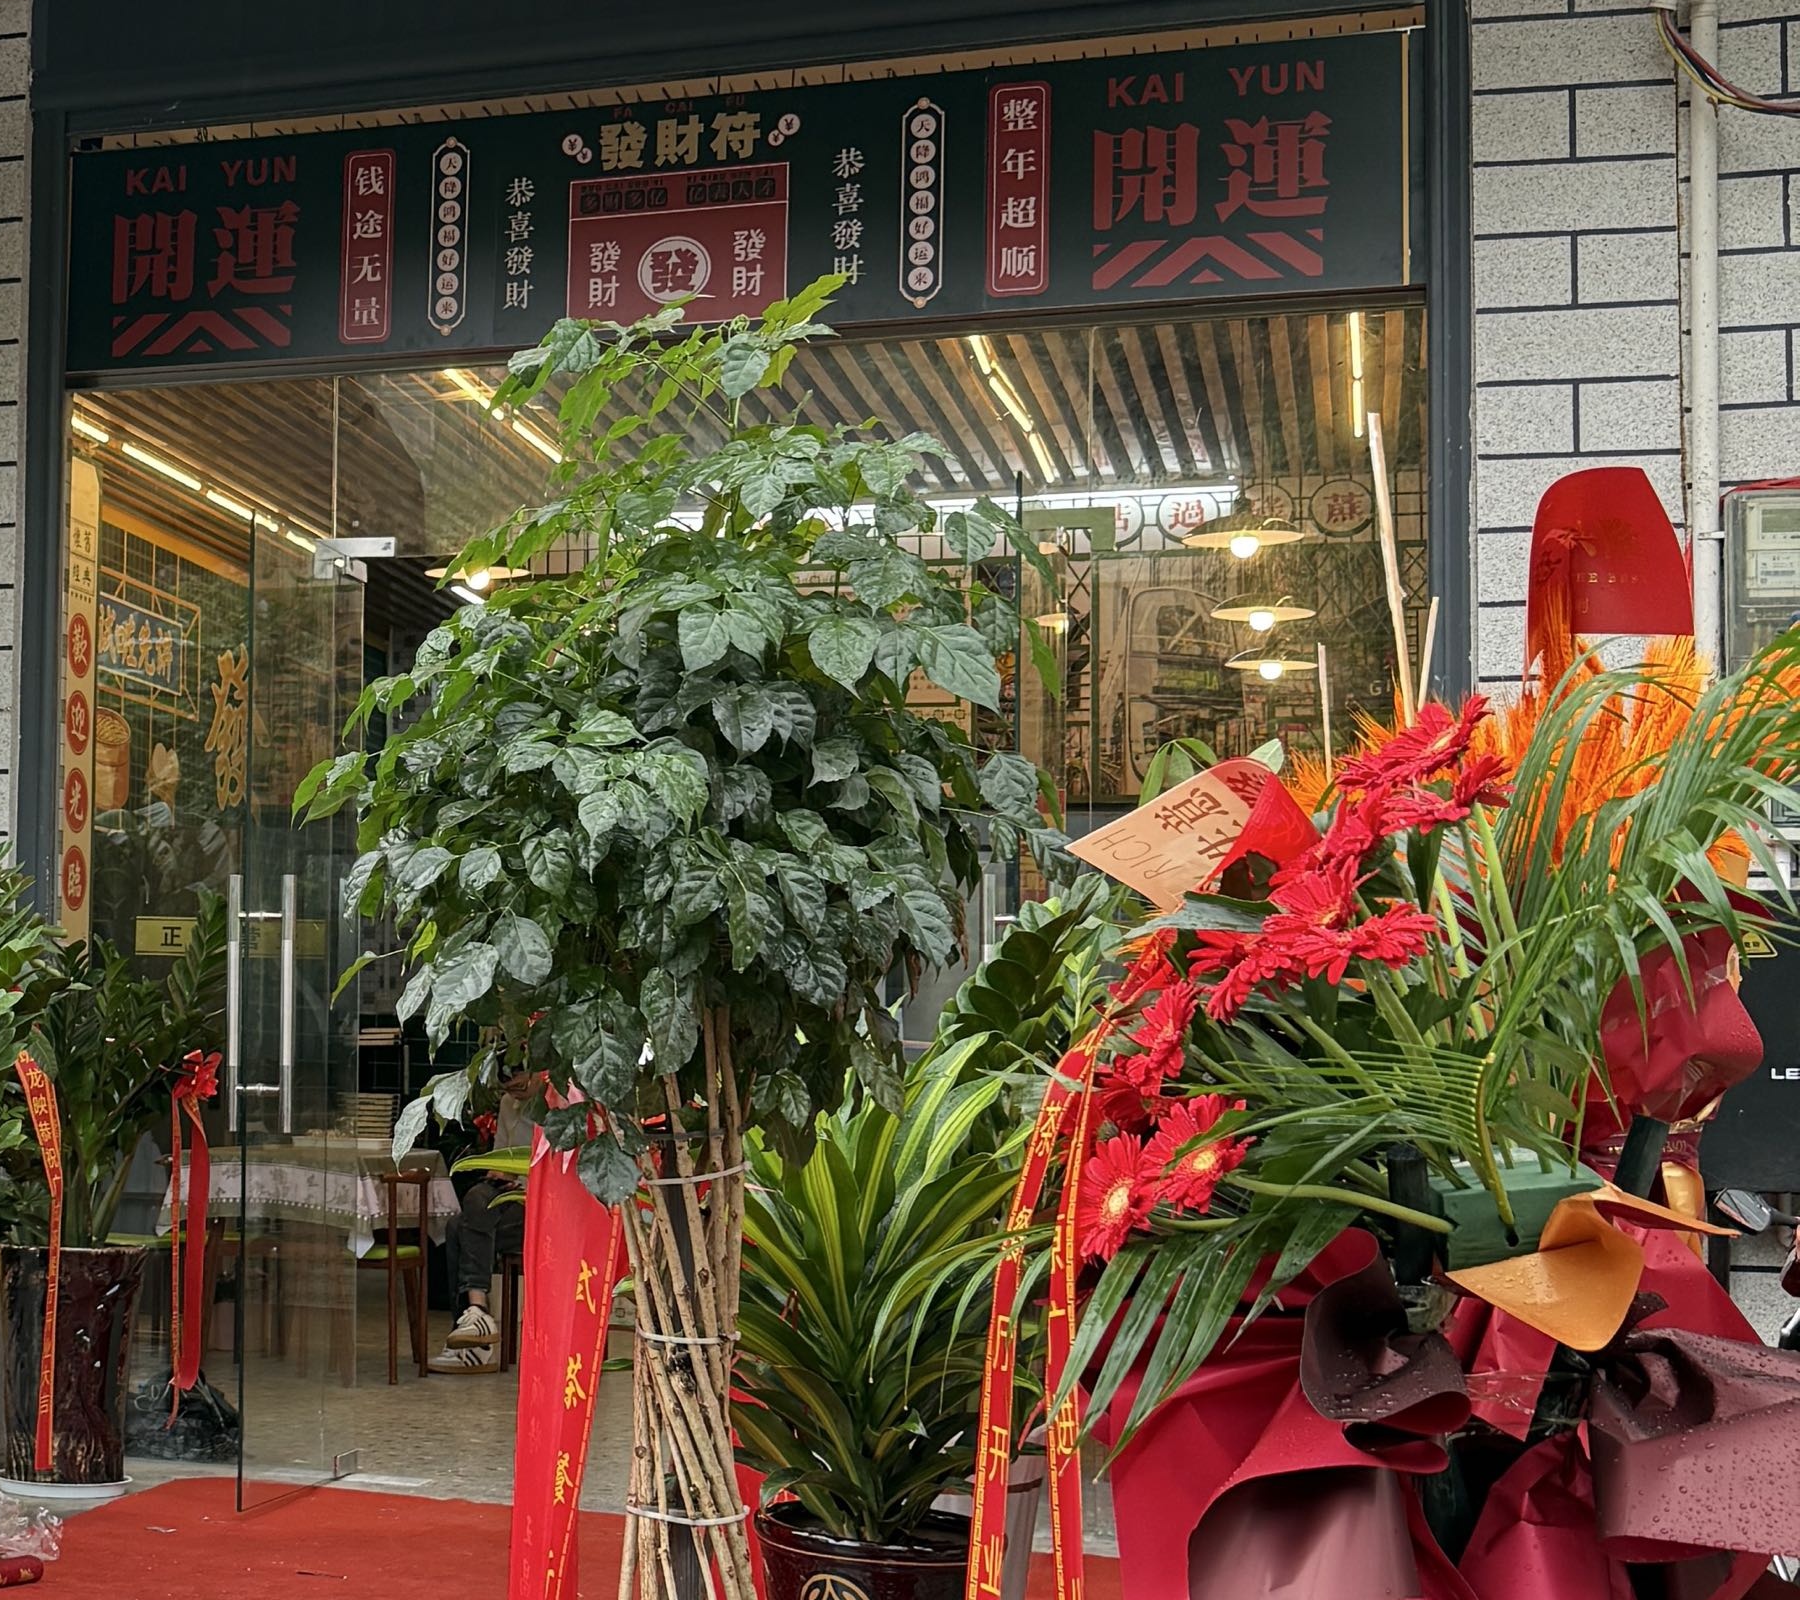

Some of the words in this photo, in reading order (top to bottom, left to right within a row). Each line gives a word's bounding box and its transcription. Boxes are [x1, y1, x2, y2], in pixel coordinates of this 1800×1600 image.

[1107, 71, 1186, 109] KAI
[1227, 59, 1327, 97] YUN
[124, 164, 188, 196] KAI
[220, 154, 297, 187] YUN
[599, 110, 762, 172] 發財符
[1091, 110, 1334, 232] 開運
[999, 97, 1038, 279] 整年超顺
[111, 199, 301, 304] 開運
[351, 165, 386, 327] 钱途无量
[588, 240, 622, 309] 發財
[732, 228, 767, 298] 發財
